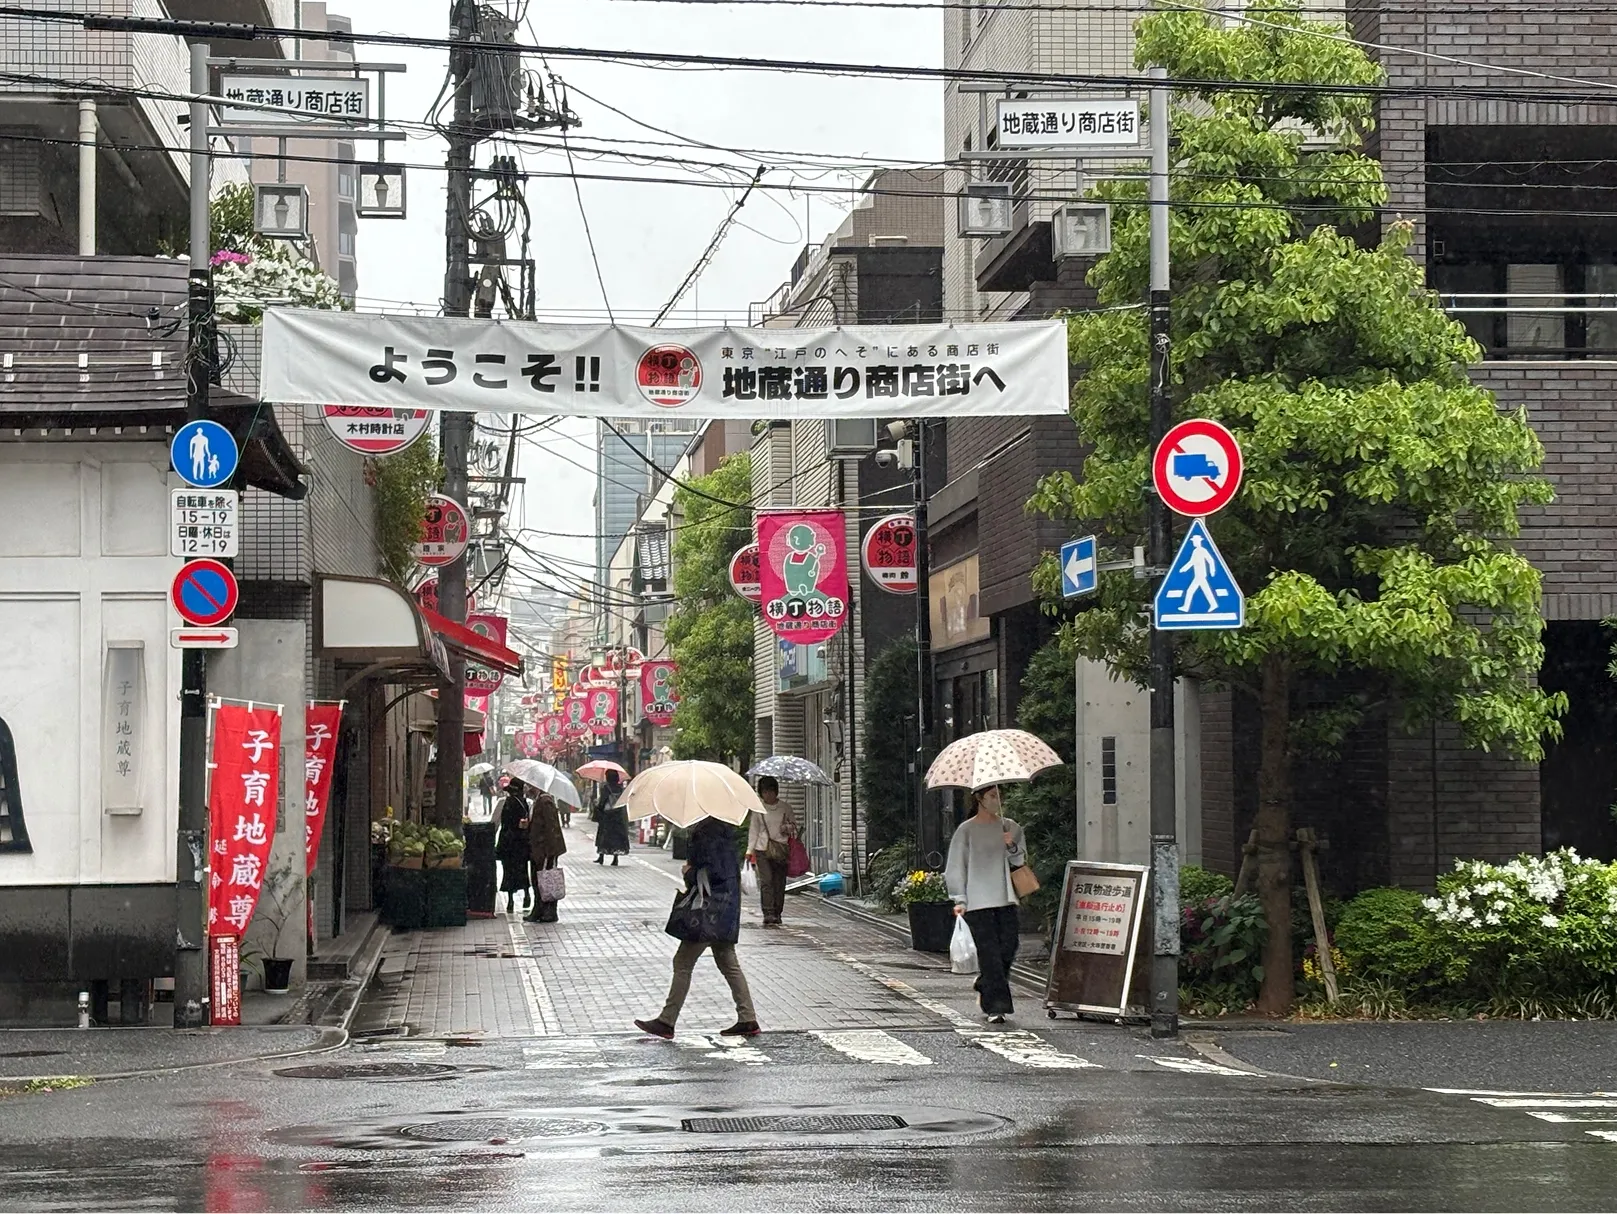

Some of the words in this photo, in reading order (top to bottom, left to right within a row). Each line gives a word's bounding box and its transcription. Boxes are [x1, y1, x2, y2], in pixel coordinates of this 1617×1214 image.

[226, 88, 363, 114] 地蔵通り商店街
[1002, 111, 1135, 135] 地蔵通り商店街
[369, 346, 601, 393] ようこそ!!
[722, 364, 1007, 401] 地蔵通り商店街へ
[346, 422, 405, 435] 木村時計店
[177, 495, 233, 509] 自転車を除く
[182, 511, 227, 523] 15-19
[178, 526, 231, 539] 日曜・休日は
[877, 529, 912, 545] 横丁
[182, 539, 227, 552] 12-19
[876, 549, 910, 565] 物語
[768, 599, 843, 617] 横丁物語
[776, 620, 837, 630] 地蔵通り商店街
[116, 681, 132, 777] 子育地蔵尊
[223, 730, 274, 931] 子育地蔵尊
[1074, 882, 1133, 898] お買物遊歩道
